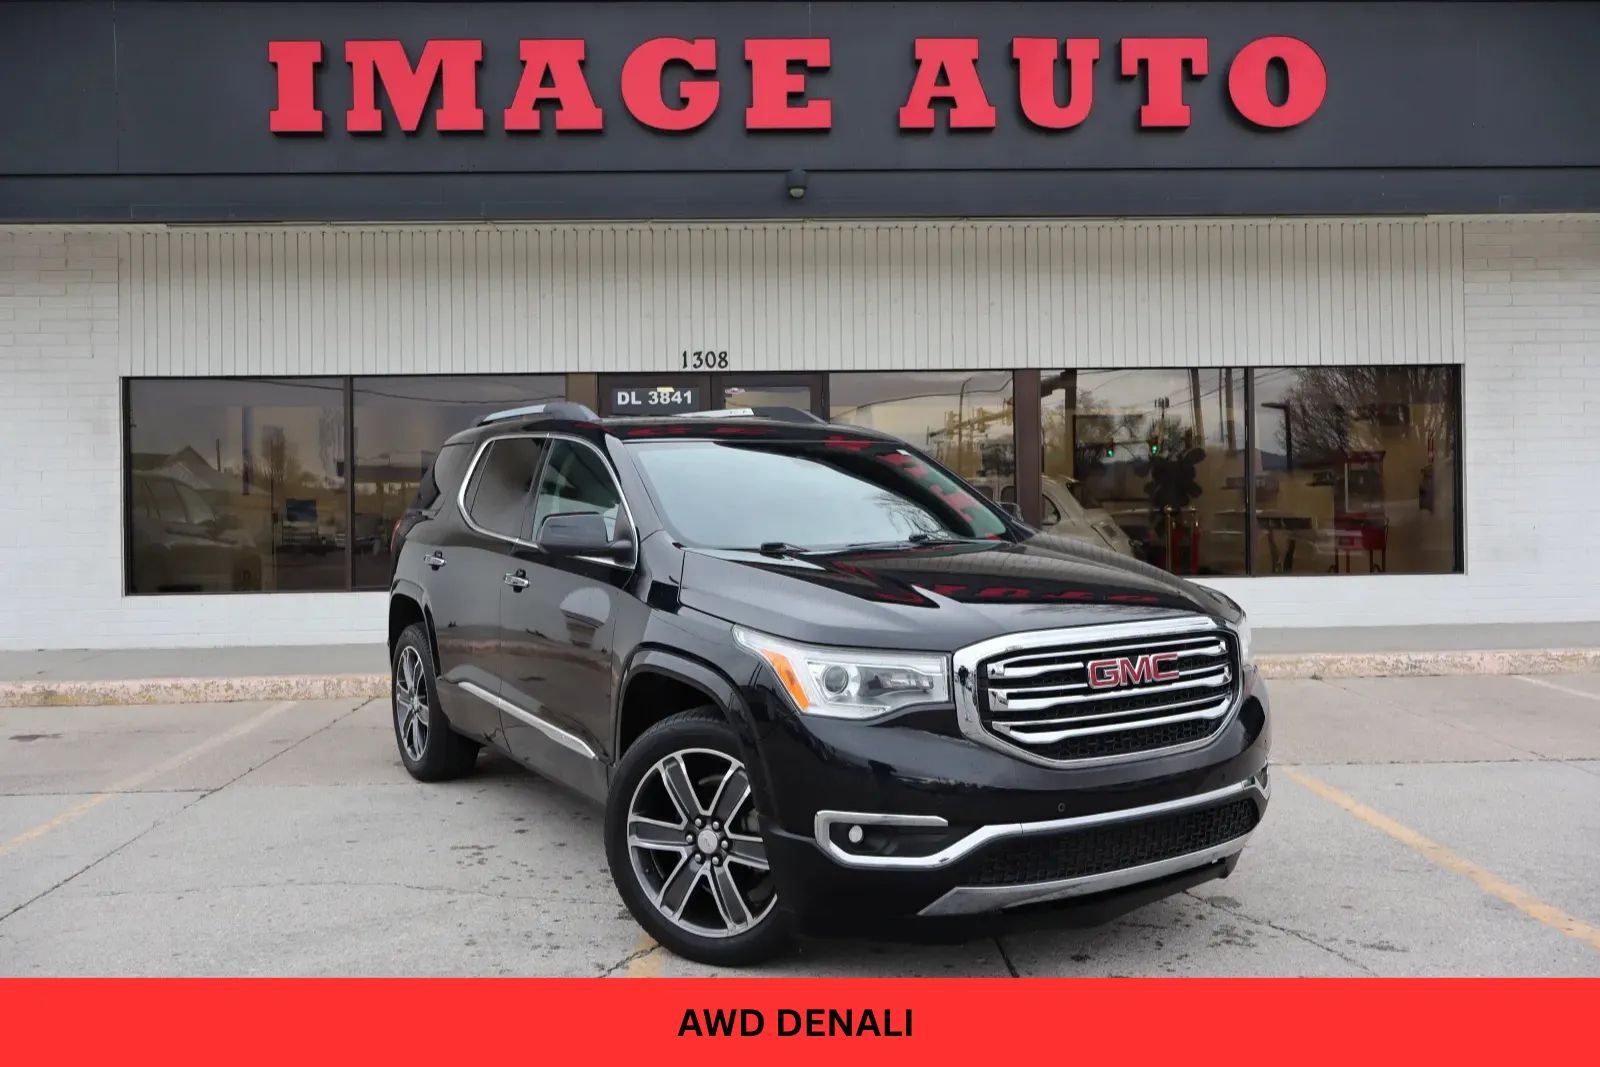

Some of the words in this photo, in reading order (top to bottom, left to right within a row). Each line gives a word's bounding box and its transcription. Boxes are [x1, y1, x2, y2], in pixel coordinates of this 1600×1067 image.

[267, 37, 833, 135] IMAGE
[898, 36, 1328, 130] AUTO
[682, 350, 728, 368] 1308
[617, 391, 641, 405] DL
[648, 390, 692, 404] 3841
[1088, 653, 1179, 688] GMC
